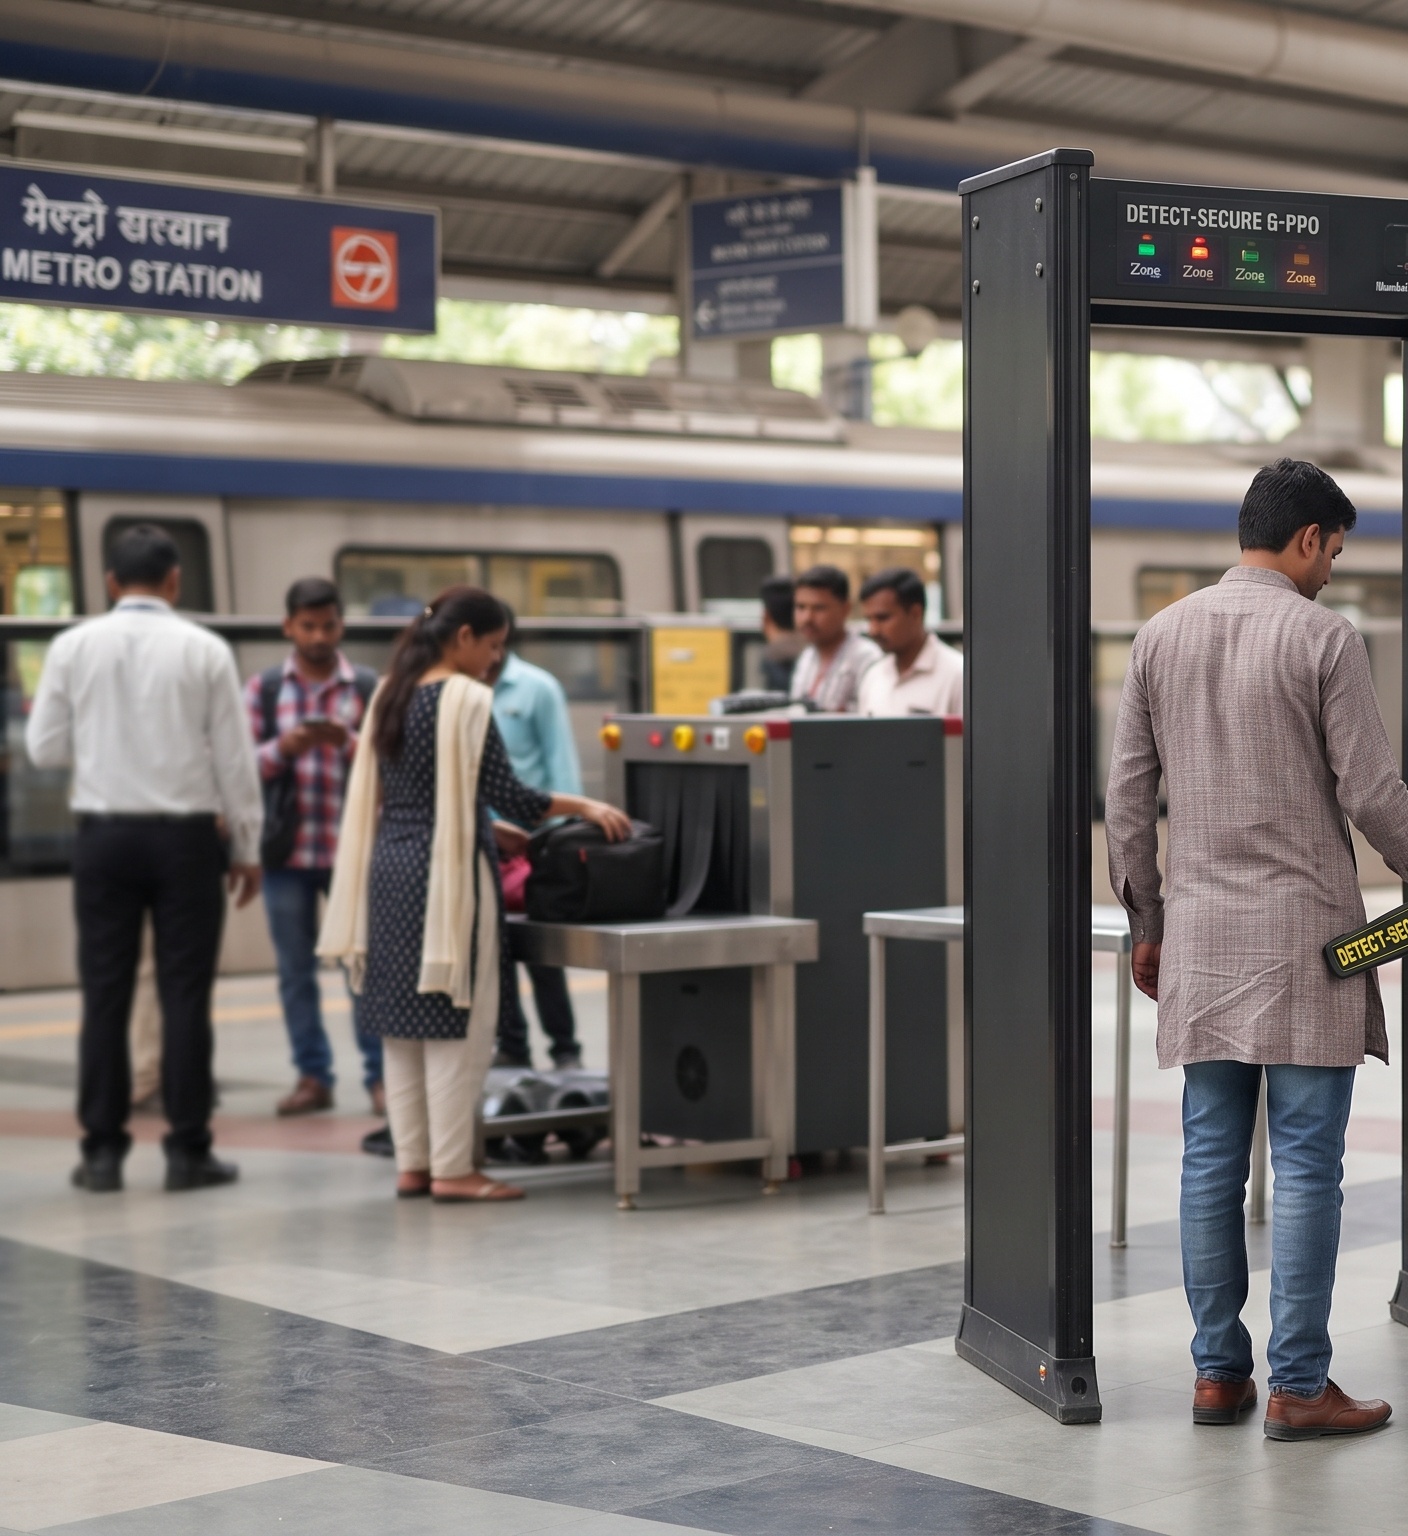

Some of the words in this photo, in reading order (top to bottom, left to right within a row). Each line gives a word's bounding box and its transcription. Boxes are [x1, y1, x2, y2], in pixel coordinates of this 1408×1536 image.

[1126, 203, 1262, 231] DETECT-SECURE
[2, 248, 122, 290] METRO
[130, 258, 262, 303] STATION
[1130, 262, 1161, 276] Zone
[1183, 264, 1214, 278] Zone
[1235, 267, 1265, 281] Zone
[1286, 270, 1316, 284] Zone
